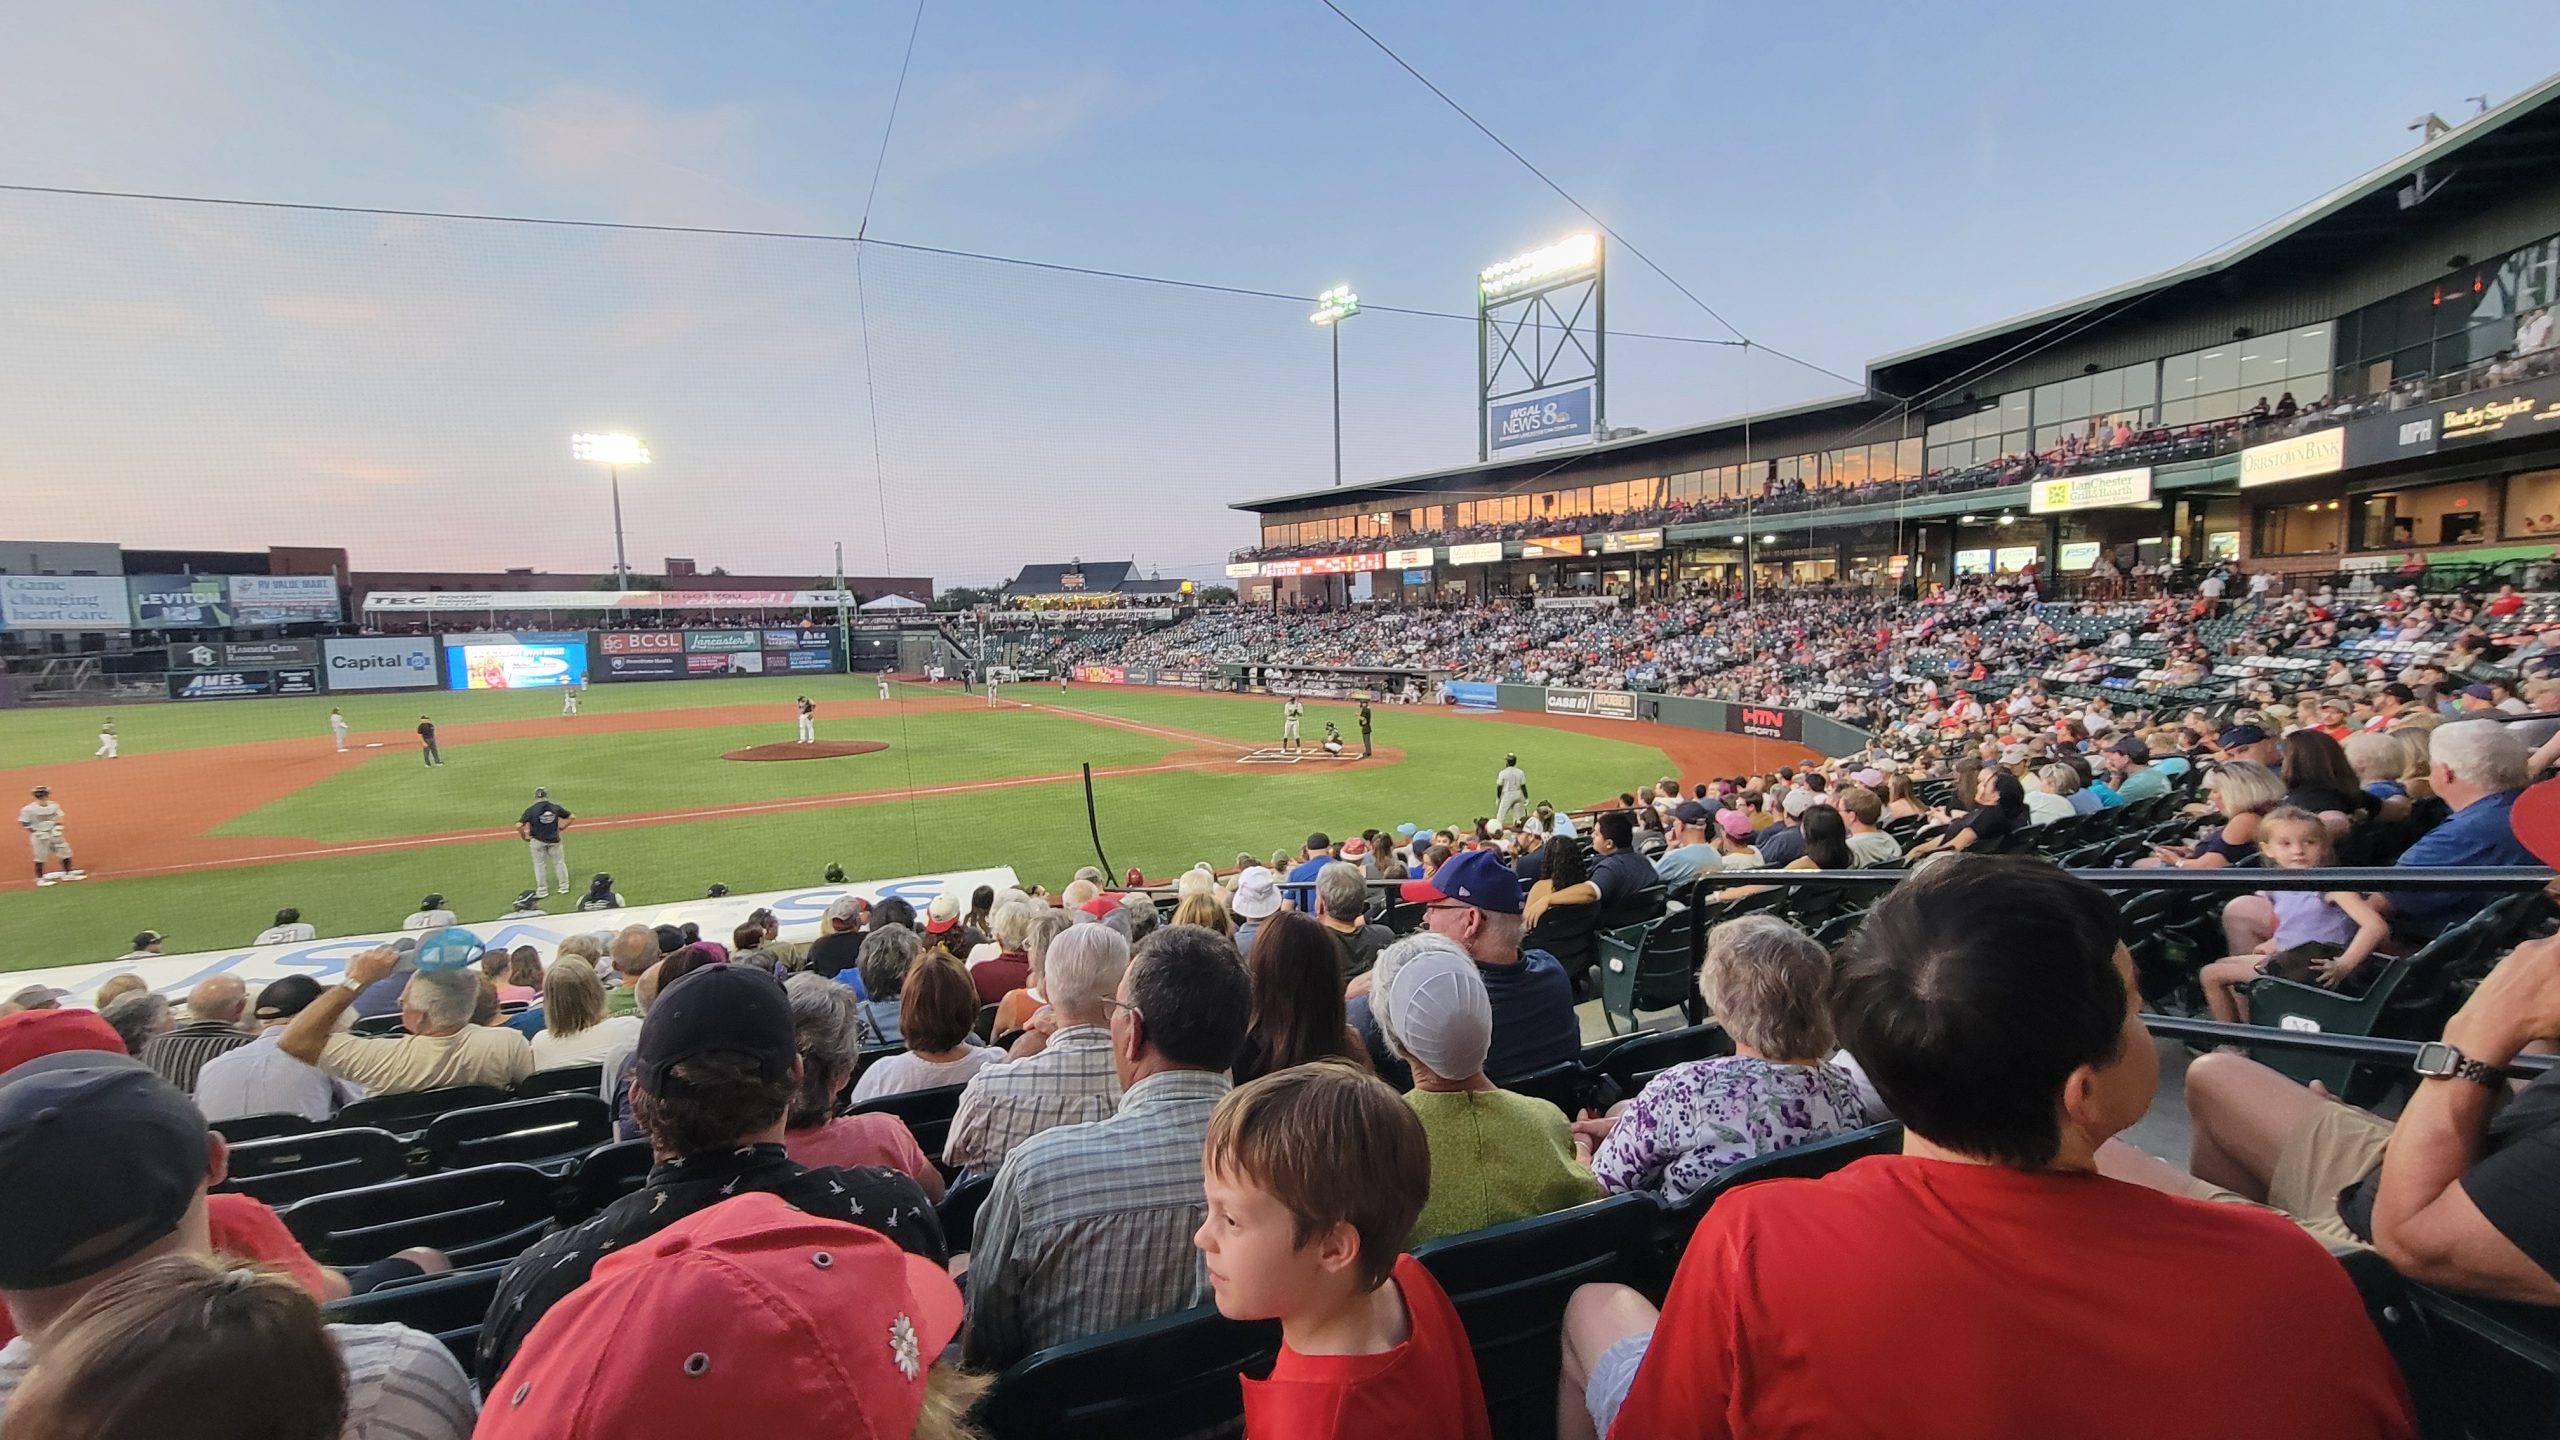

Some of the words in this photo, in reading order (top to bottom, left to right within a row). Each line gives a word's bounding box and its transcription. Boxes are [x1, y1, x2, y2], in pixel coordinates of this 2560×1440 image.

[1510, 404, 1541, 418] WGAL
[1542, 402, 1557, 425] 8
[1503, 414, 1540, 435] NEWS
[2071, 476, 2133, 491] LanChester
[7, 579, 65, 591] Game
[10, 594, 99, 607] changing
[138, 592, 221, 604] LEVITON
[371, 597, 427, 605] TEC
[12, 609, 62, 620] heart
[68, 610, 112, 620] care.
[629, 634, 679, 648] BCGL
[690, 634, 745, 650] Lancaster
[332, 654, 402, 671] Capital
[1548, 696, 1577, 708] CASE
[1742, 708, 1784, 728] HTN
[1744, 725, 1780, 738] SPORTS
